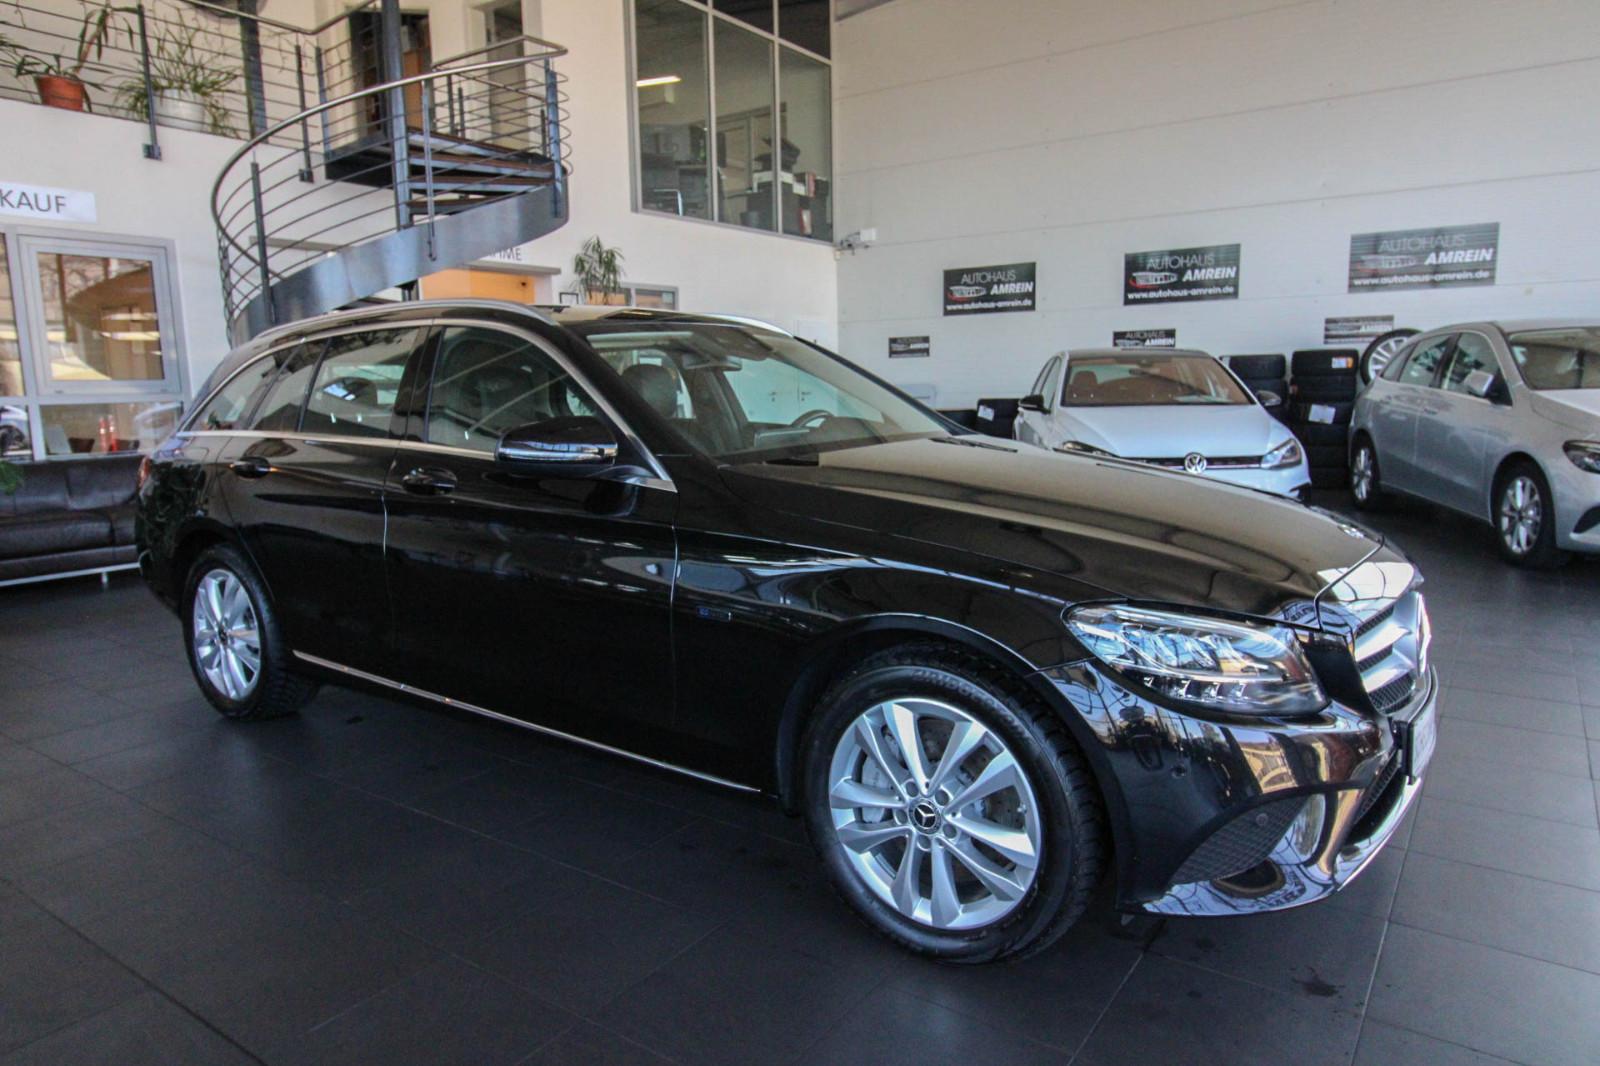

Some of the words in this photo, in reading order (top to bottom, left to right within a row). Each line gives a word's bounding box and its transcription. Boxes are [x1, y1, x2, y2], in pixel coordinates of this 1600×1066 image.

[0, 188, 66, 213] KAUF
[1377, 234, 1466, 253] AUTOHAUS
[1146, 253, 1215, 270] AUTOHAUS
[1424, 247, 1494, 266] AMREIN
[960, 269, 1017, 285] AUTOHAUS
[1182, 266, 1237, 282] AMREIN
[1353, 269, 1490, 286] www.autohaus-amrein.de
[990, 281, 1034, 296] AMREIN
[1127, 285, 1235, 300] www.autohaus-amrein.de
